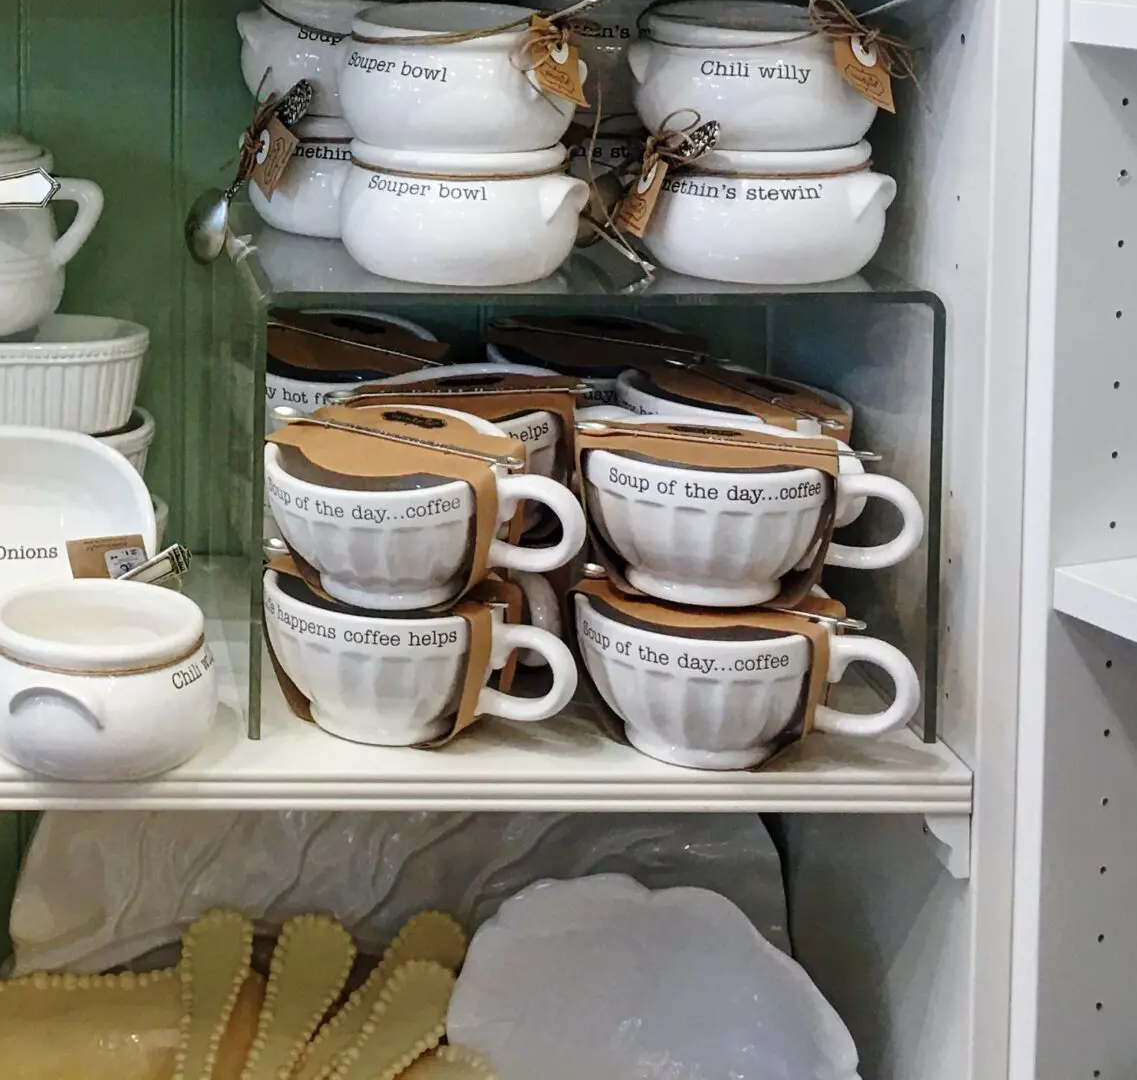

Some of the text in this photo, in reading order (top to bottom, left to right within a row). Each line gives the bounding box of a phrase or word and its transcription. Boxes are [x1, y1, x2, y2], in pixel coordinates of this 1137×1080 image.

[348, 51, 448, 83] Souper bowl
[700, 60, 812, 84] Chili willy
[367, 174, 488, 201] Souper bowl
[745, 183, 825, 201] stewin'
[282, 387, 309, 405] hot
[267, 476, 292, 505] Soup
[295, 497, 310, 511] of
[315, 500, 345, 518] the
[608, 467, 650, 493] Soup
[656, 480, 678, 496] of
[684, 482, 719, 500] the
[276, 604, 337, 640] happens
[343, 628, 401, 647] coffee
[407, 629, 458, 648] helps
[582, 620, 611, 651] Soup
[615, 641, 632, 657] of
[638, 644, 670, 666] the
[171, 662, 203, 690] Chili
